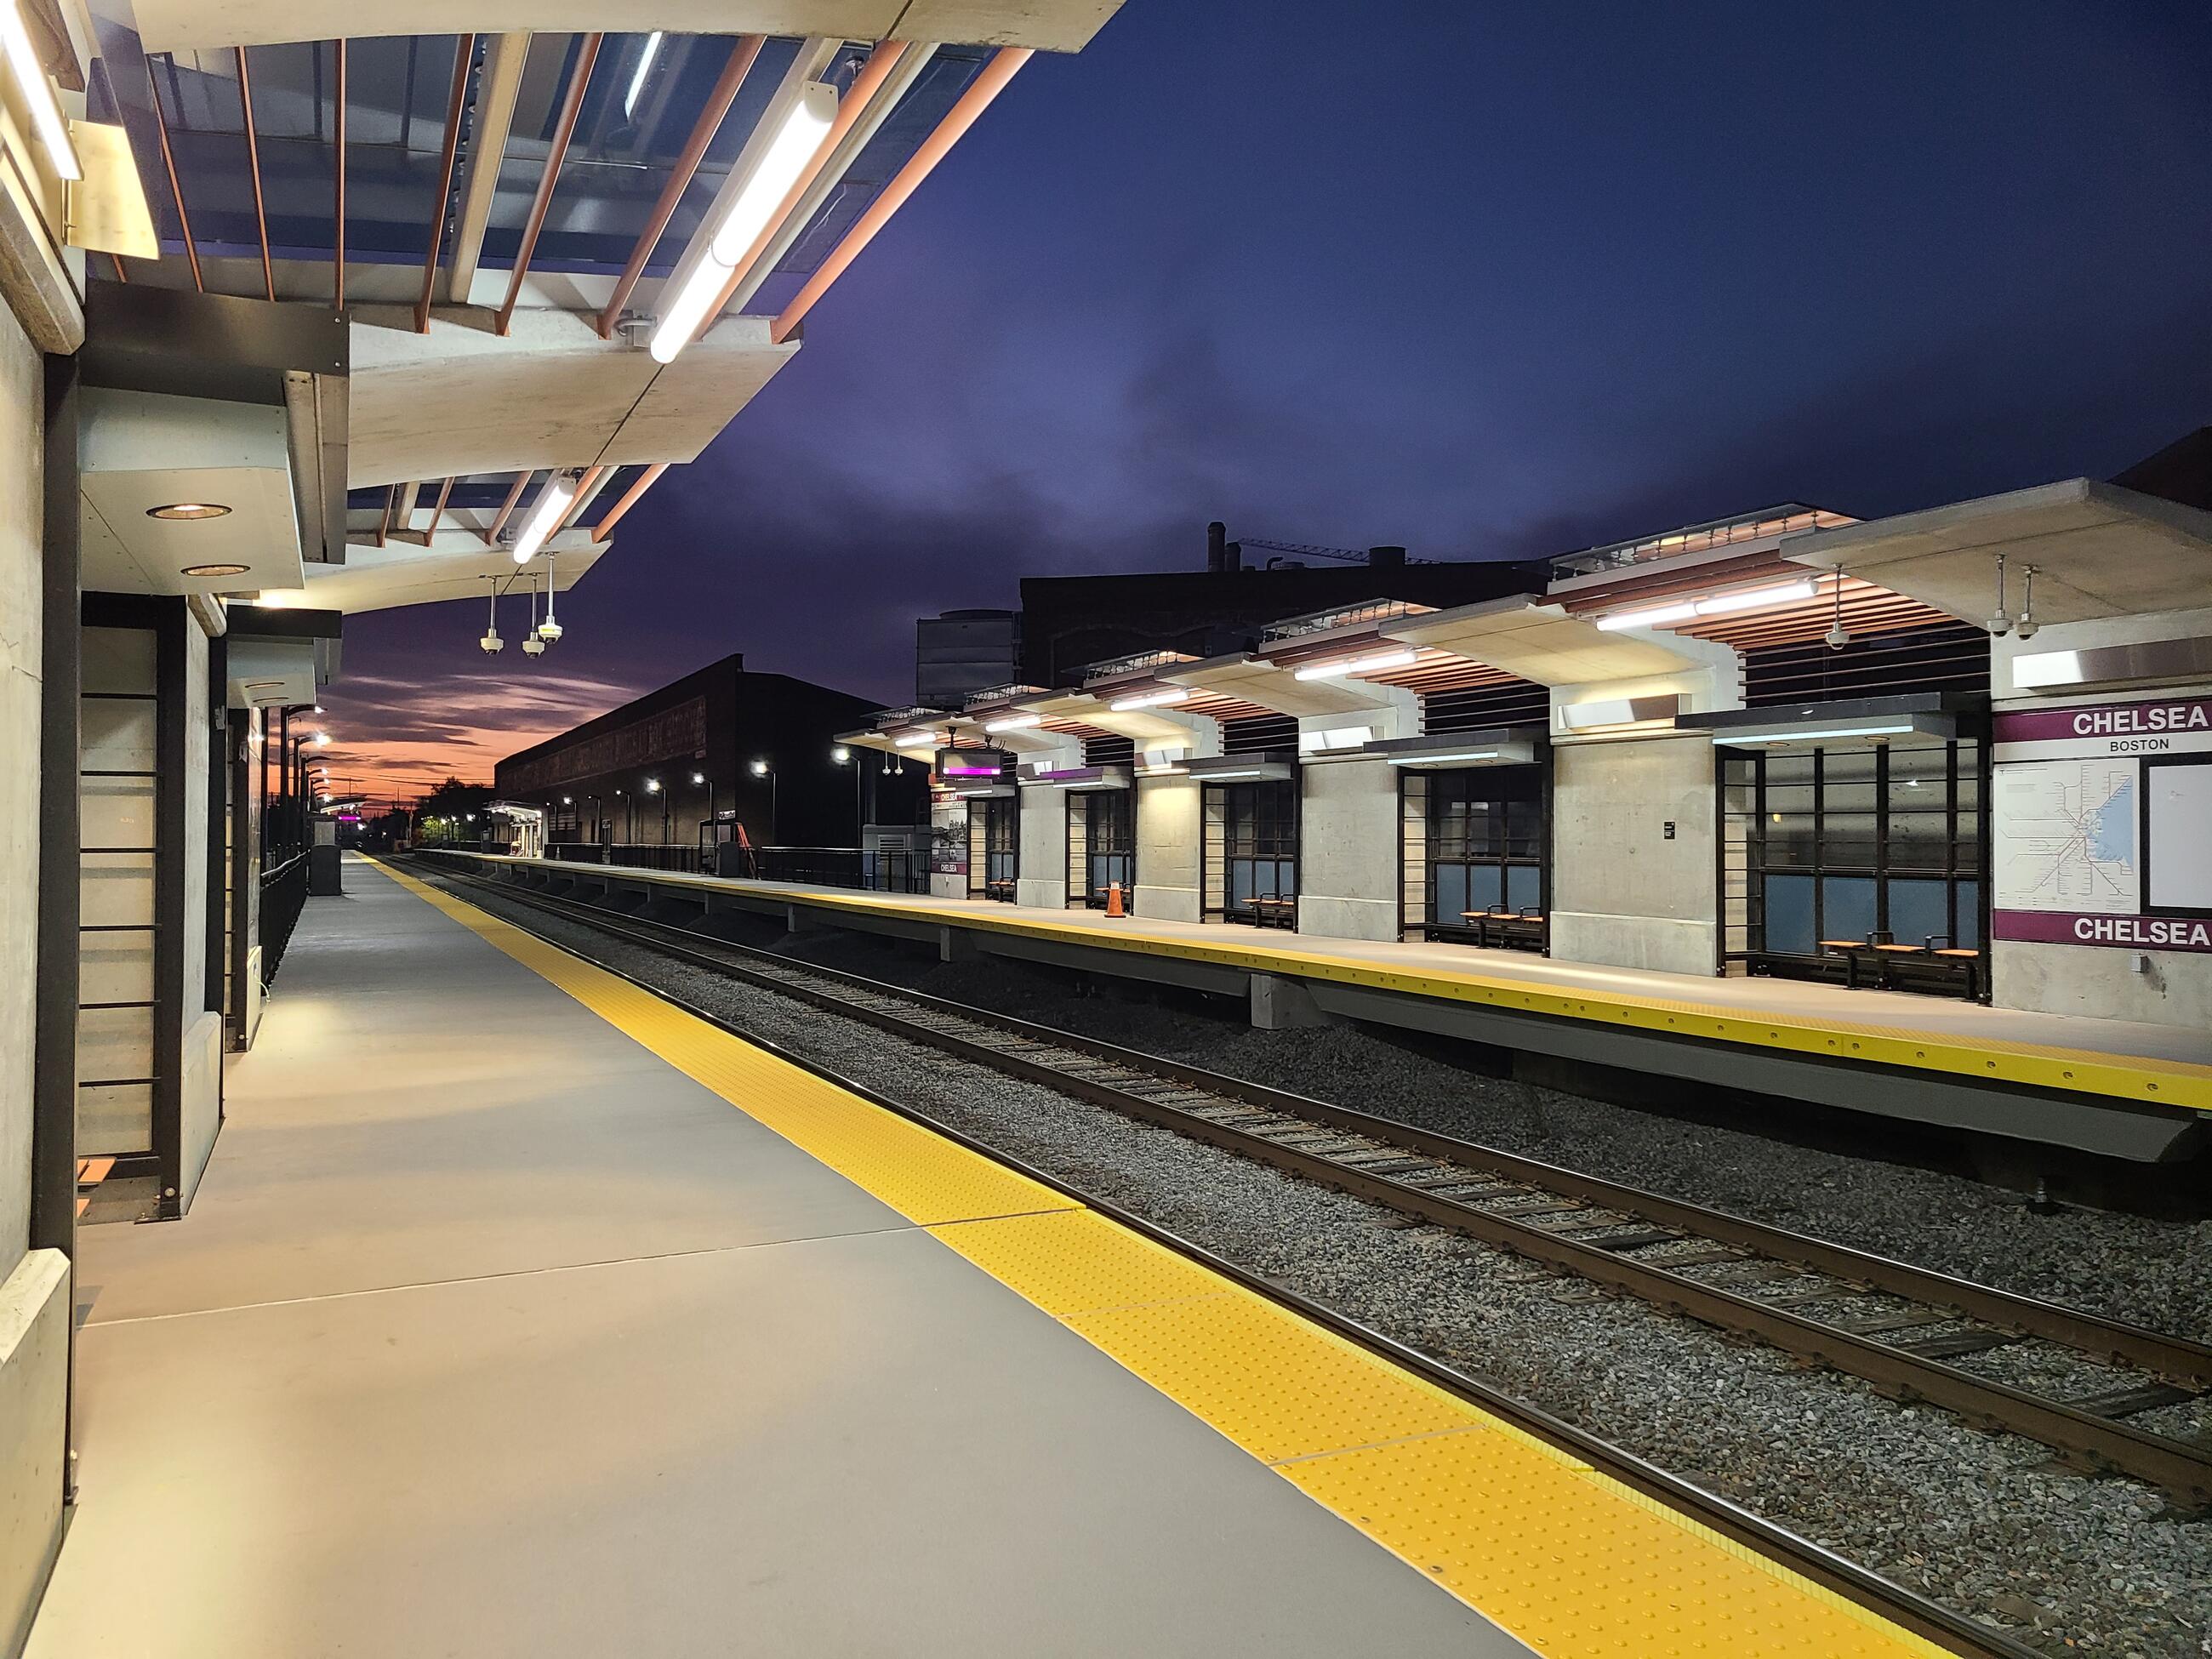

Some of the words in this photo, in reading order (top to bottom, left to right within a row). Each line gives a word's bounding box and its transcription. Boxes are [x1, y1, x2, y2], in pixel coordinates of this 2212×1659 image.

[2073, 705, 2209, 735] CHELSEA
[2110, 738, 2169, 752] BOSTON
[941, 864, 957, 872] CHELSEA
[2074, 918, 2211, 946] CHELSEA
